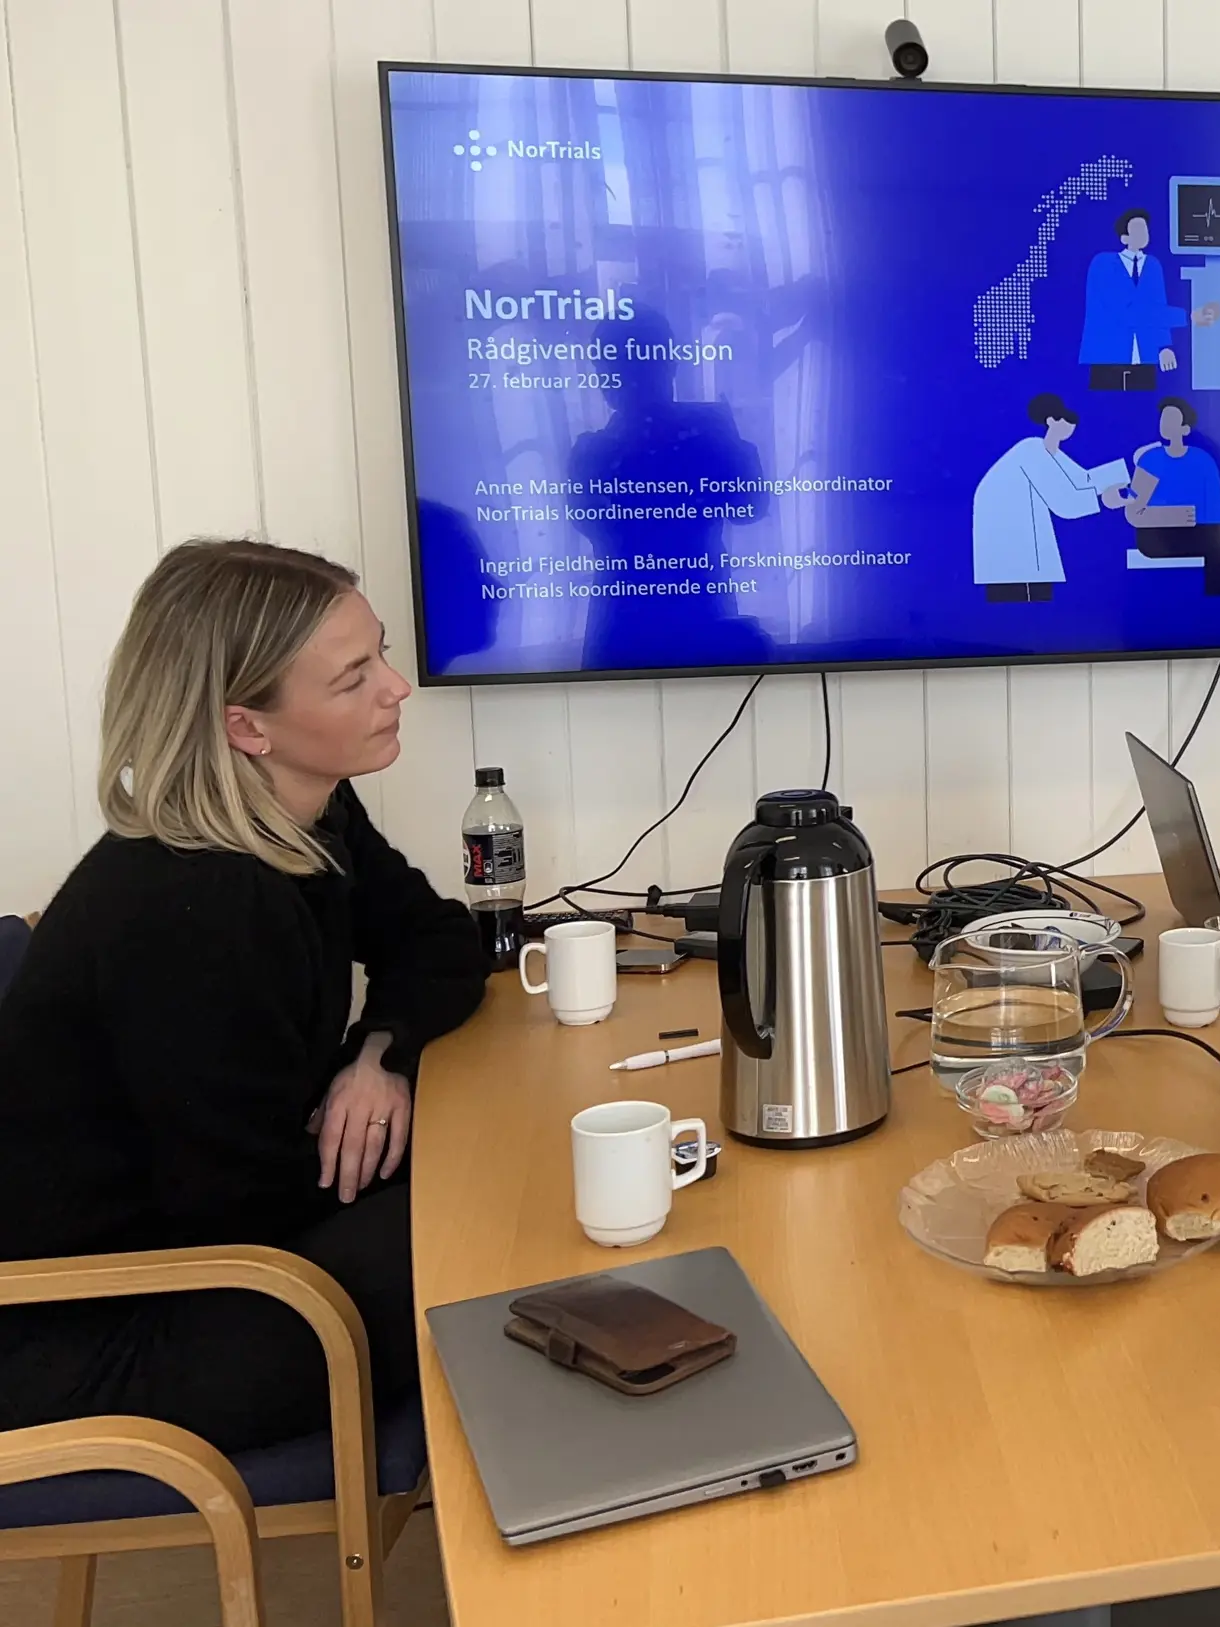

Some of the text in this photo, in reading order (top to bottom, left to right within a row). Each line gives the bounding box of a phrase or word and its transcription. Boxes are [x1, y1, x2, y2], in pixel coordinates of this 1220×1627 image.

[508, 140, 601, 160] NorTrials
[465, 289, 635, 321] NorTrials
[468, 337, 733, 366] Rådgivende funksjon
[468, 372, 622, 389] 27. februar 2025
[475, 476, 893, 495] Anne Marie Halstensen, Forskningskoordinator
[477, 502, 754, 521] NorTrials koordinerende enhet
[479, 549, 911, 577] Ingrid Fjeldheim Bånerud, Forskningskoordinator
[481, 578, 756, 599] NorTrials koordinerende enhet
[471, 844, 484, 877] MAX
